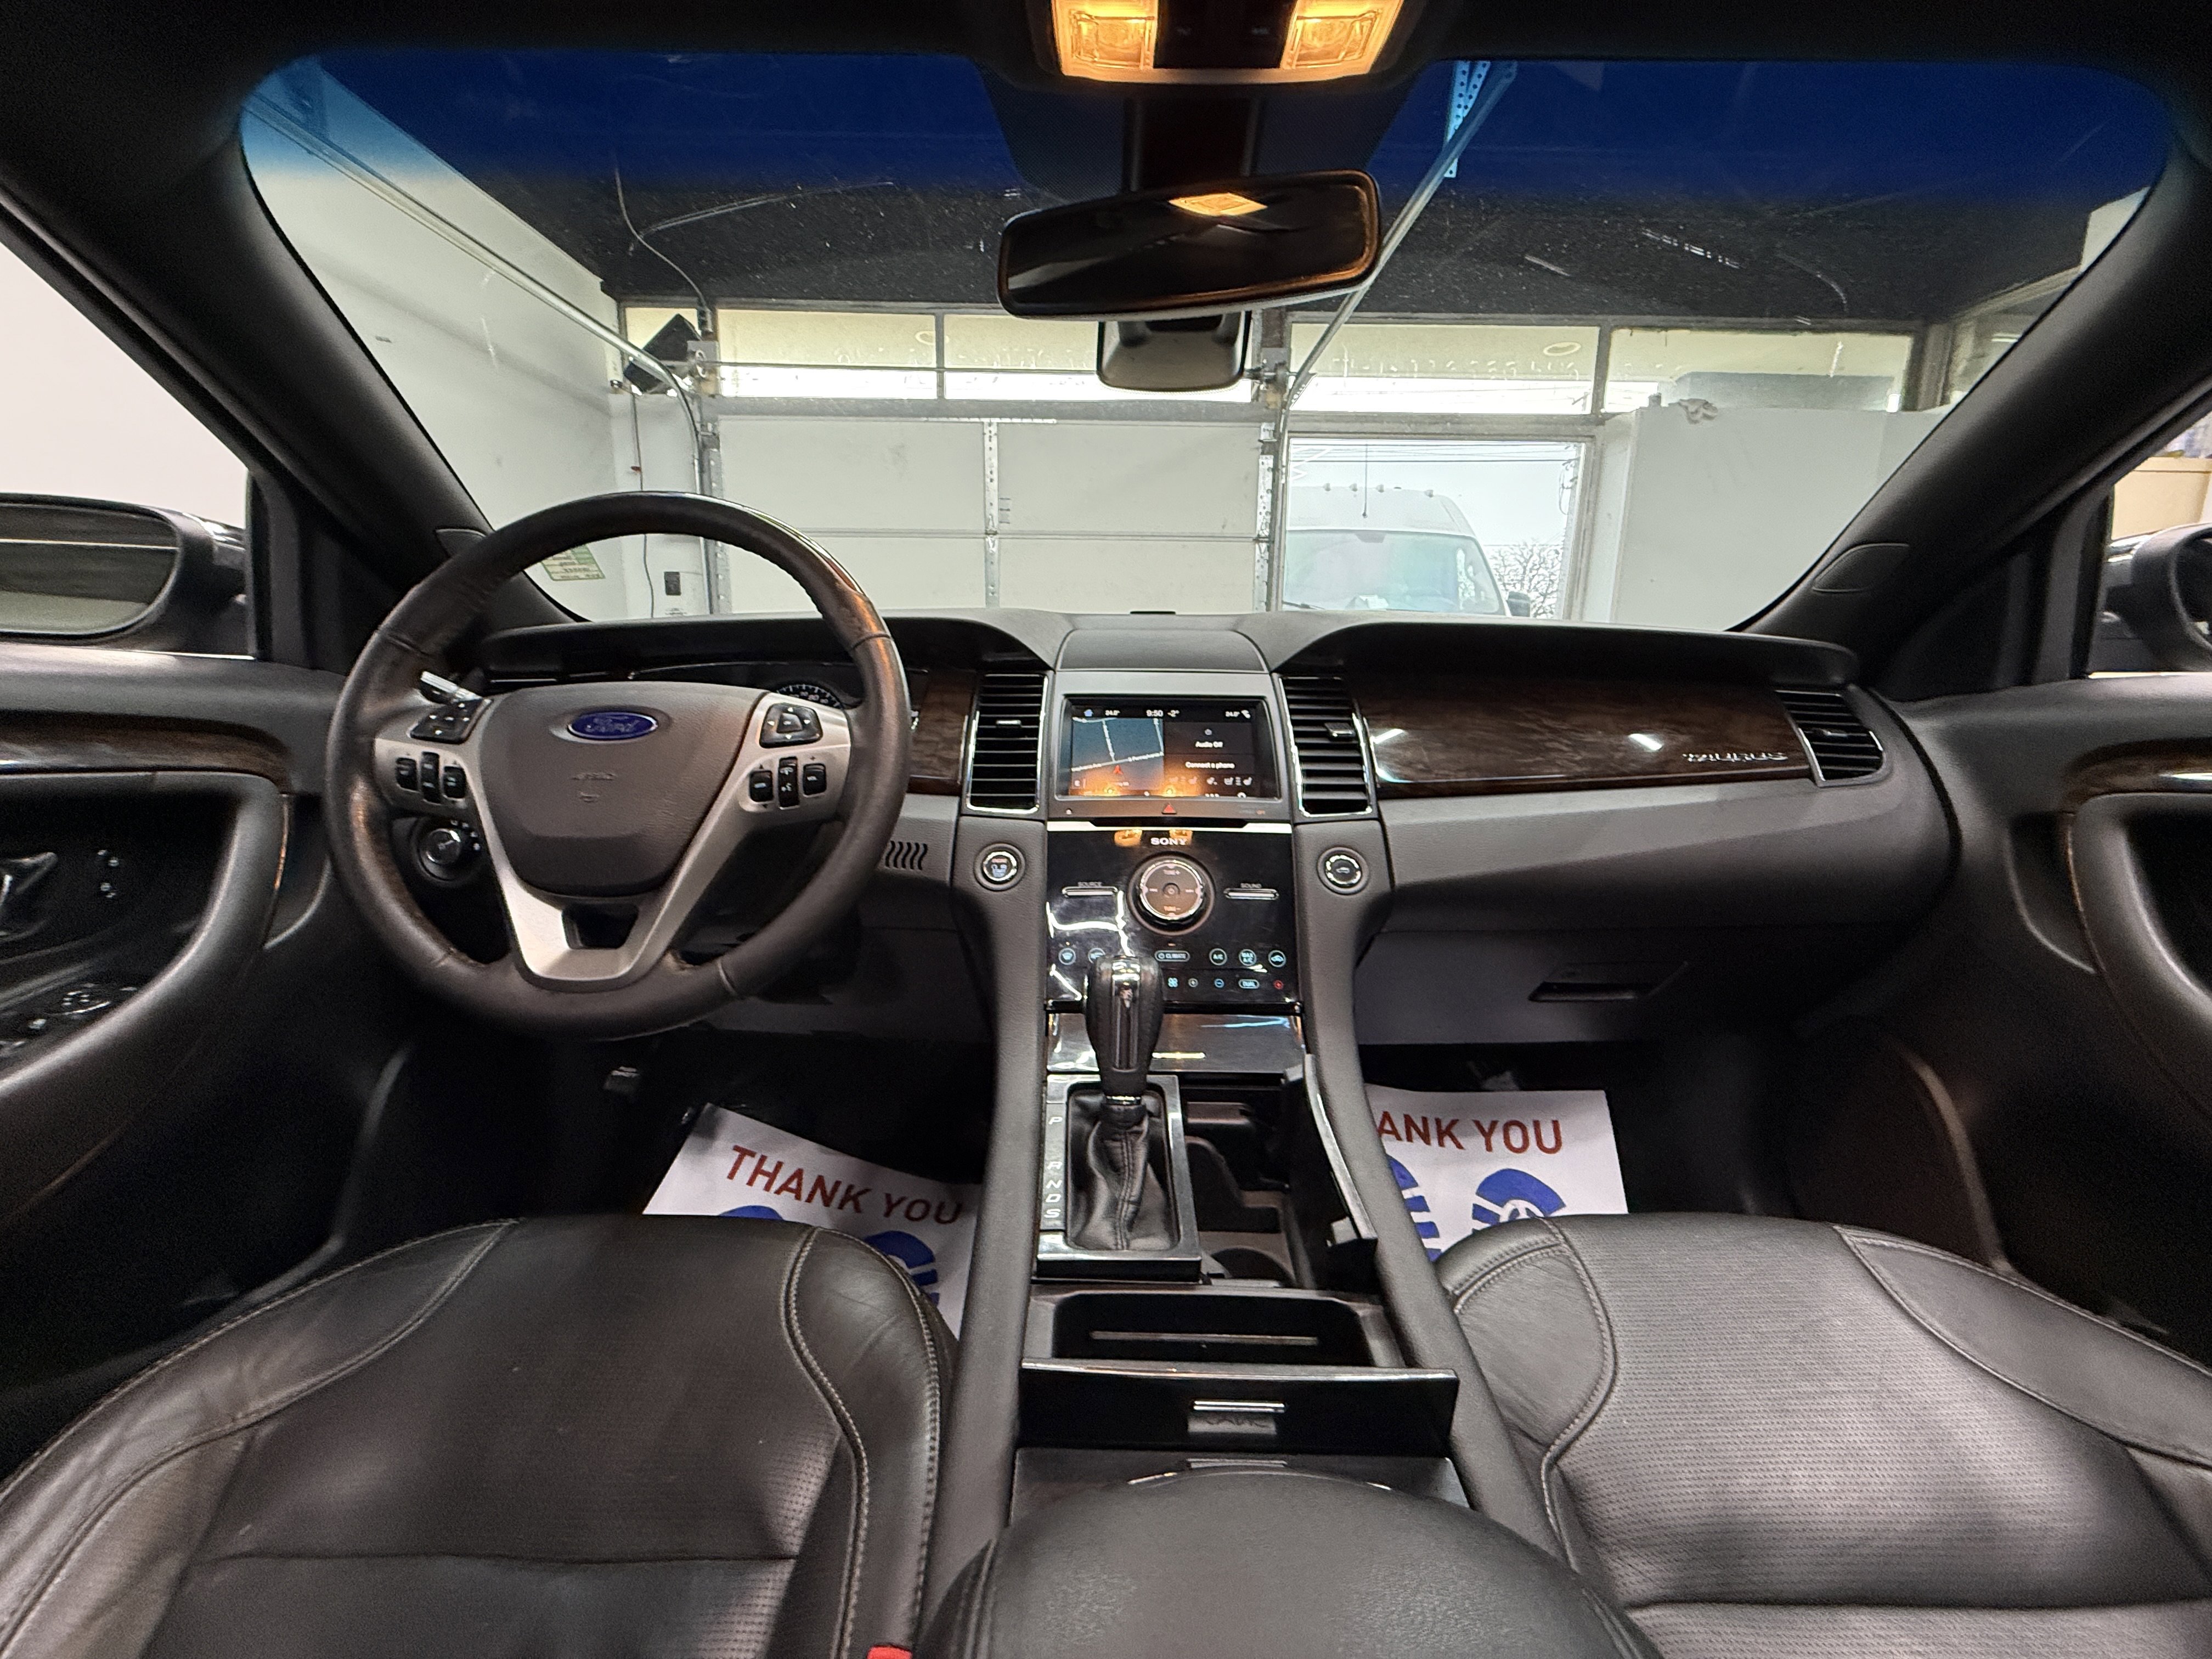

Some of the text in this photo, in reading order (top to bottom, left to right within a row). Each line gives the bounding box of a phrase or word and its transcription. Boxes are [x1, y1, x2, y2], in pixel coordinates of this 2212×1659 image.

[1682, 752, 1788, 763] TAURUS
[1150, 837, 1188, 845] SONY
[1048, 1116, 1062, 1125] P
[1376, 1111, 1563, 1154] ANK YOU
[1047, 1161, 1063, 1170] R
[726, 1144, 962, 1224] THANK YOU
[1046, 1180, 1063, 1189] N
[1045, 1194, 1062, 1203] D
[1044, 1208, 1061, 1218] S
